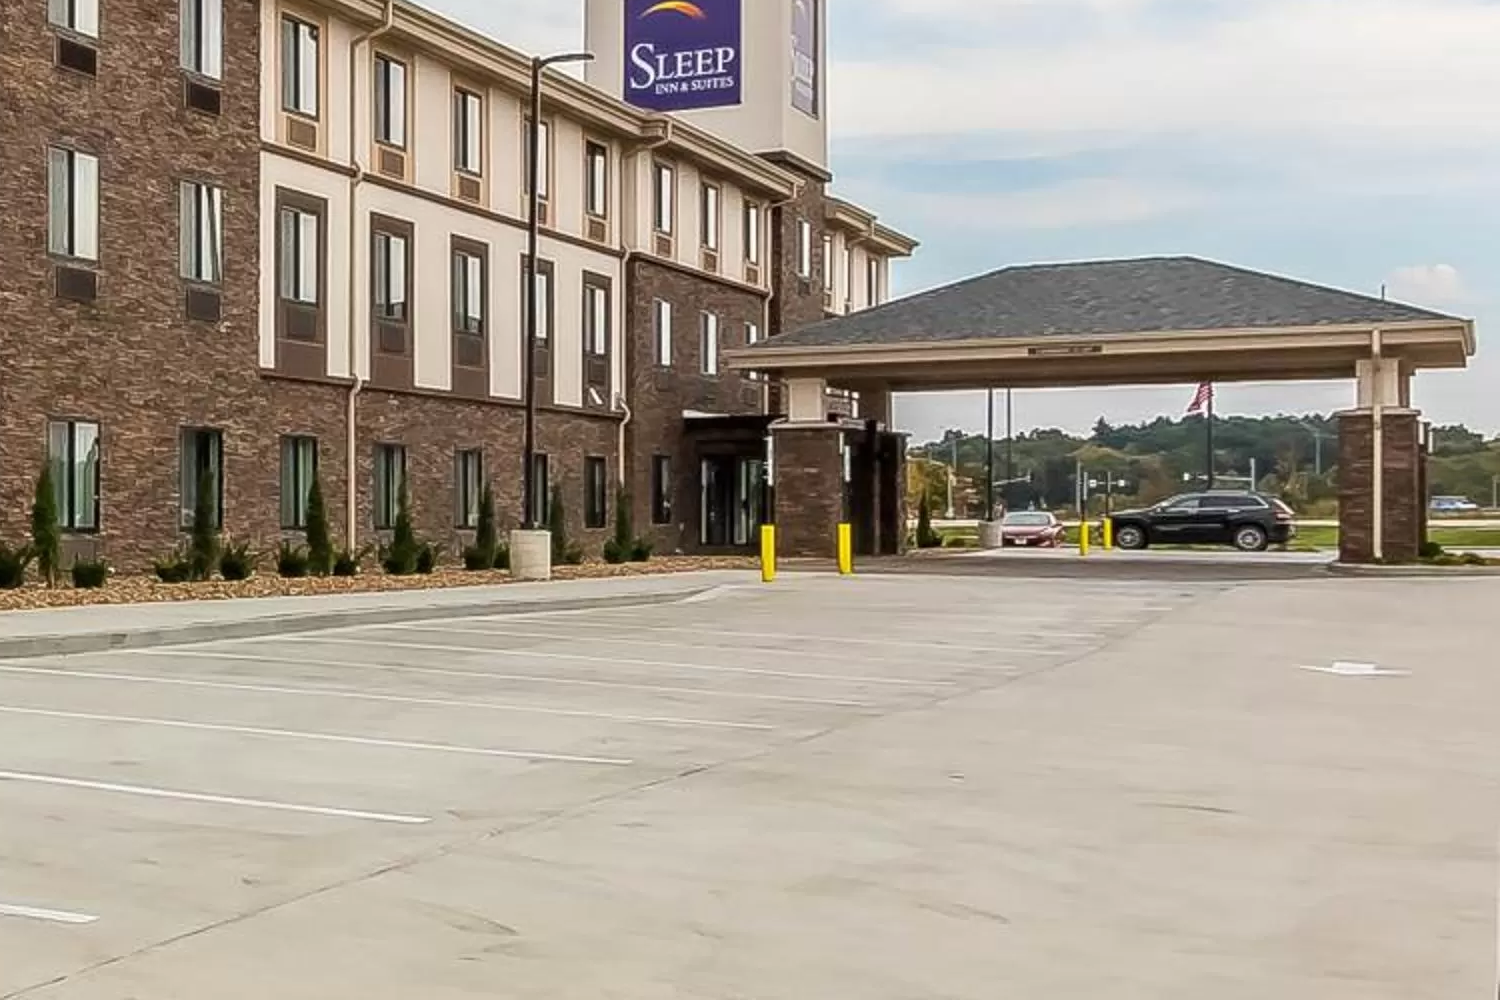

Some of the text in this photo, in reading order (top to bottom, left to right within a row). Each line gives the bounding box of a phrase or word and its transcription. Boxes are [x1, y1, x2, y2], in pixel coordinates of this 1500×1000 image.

[630, 43, 735, 89] SLEEP
[656, 76, 734, 95] INN & SUITES
